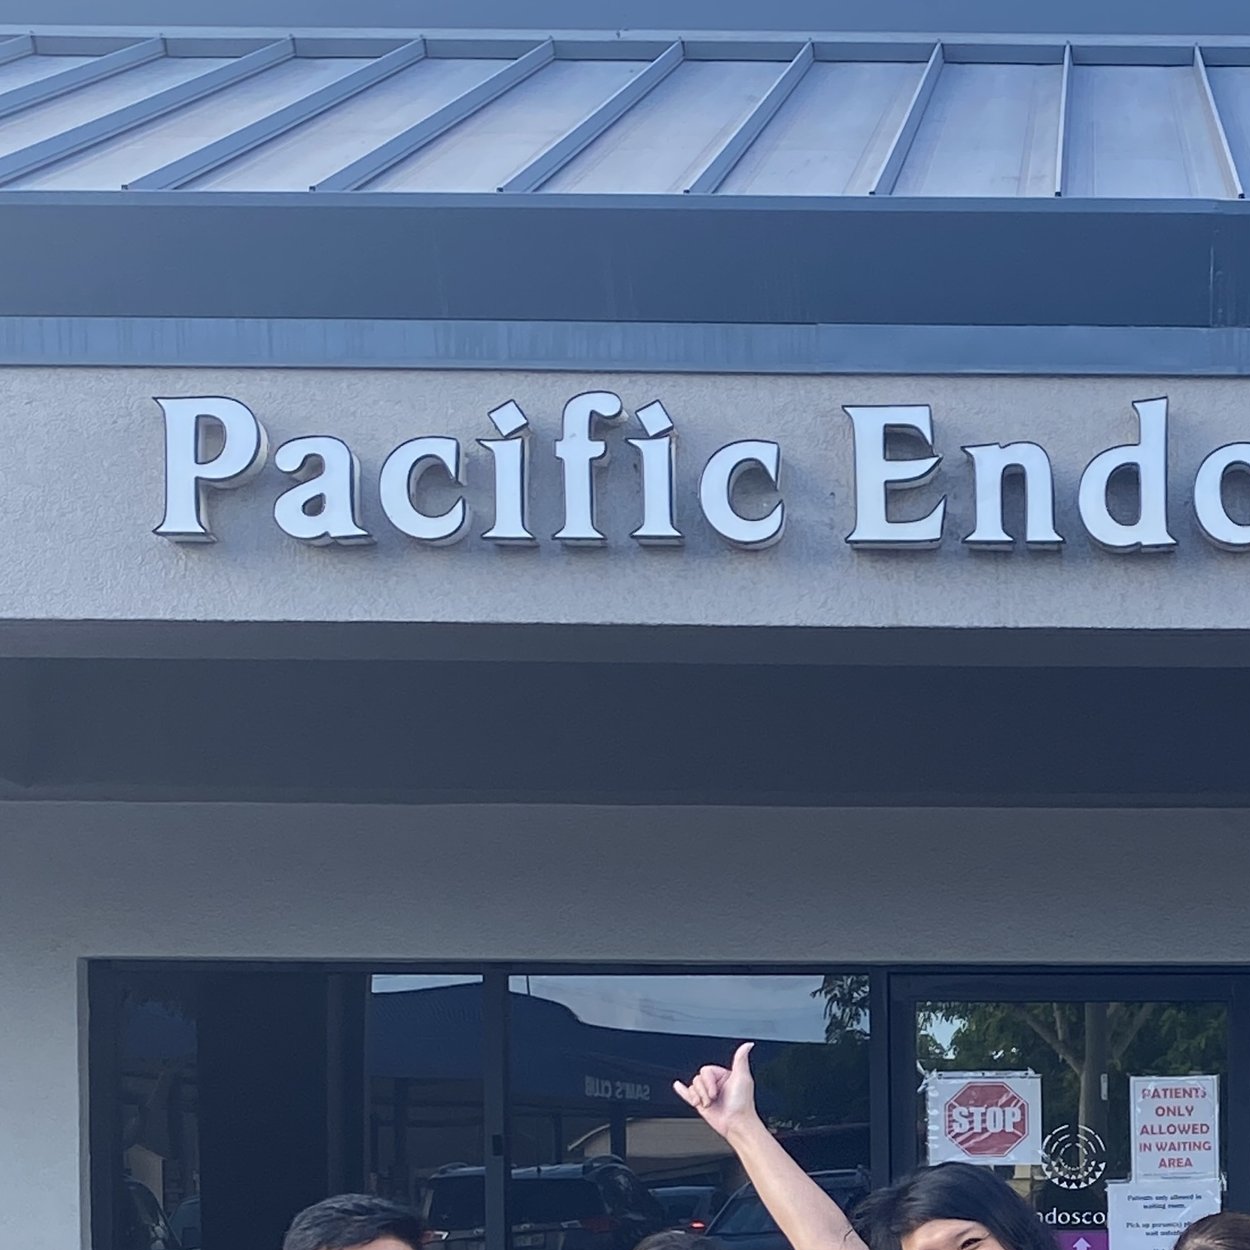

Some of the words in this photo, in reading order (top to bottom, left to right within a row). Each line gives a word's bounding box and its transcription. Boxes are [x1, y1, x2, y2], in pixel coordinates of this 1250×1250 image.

[152, 390, 786, 548] Pacific
[1141, 1087, 1207, 1099] PATIENTS
[1155, 1105, 1194, 1117] ONLY
[952, 1106, 1021, 1133] STOP
[1140, 1123, 1210, 1135] ALLOWED
[1139, 1142, 1152, 1152] IN
[1155, 1141, 1212, 1152] WAITING
[1158, 1158, 1193, 1168] AREA
